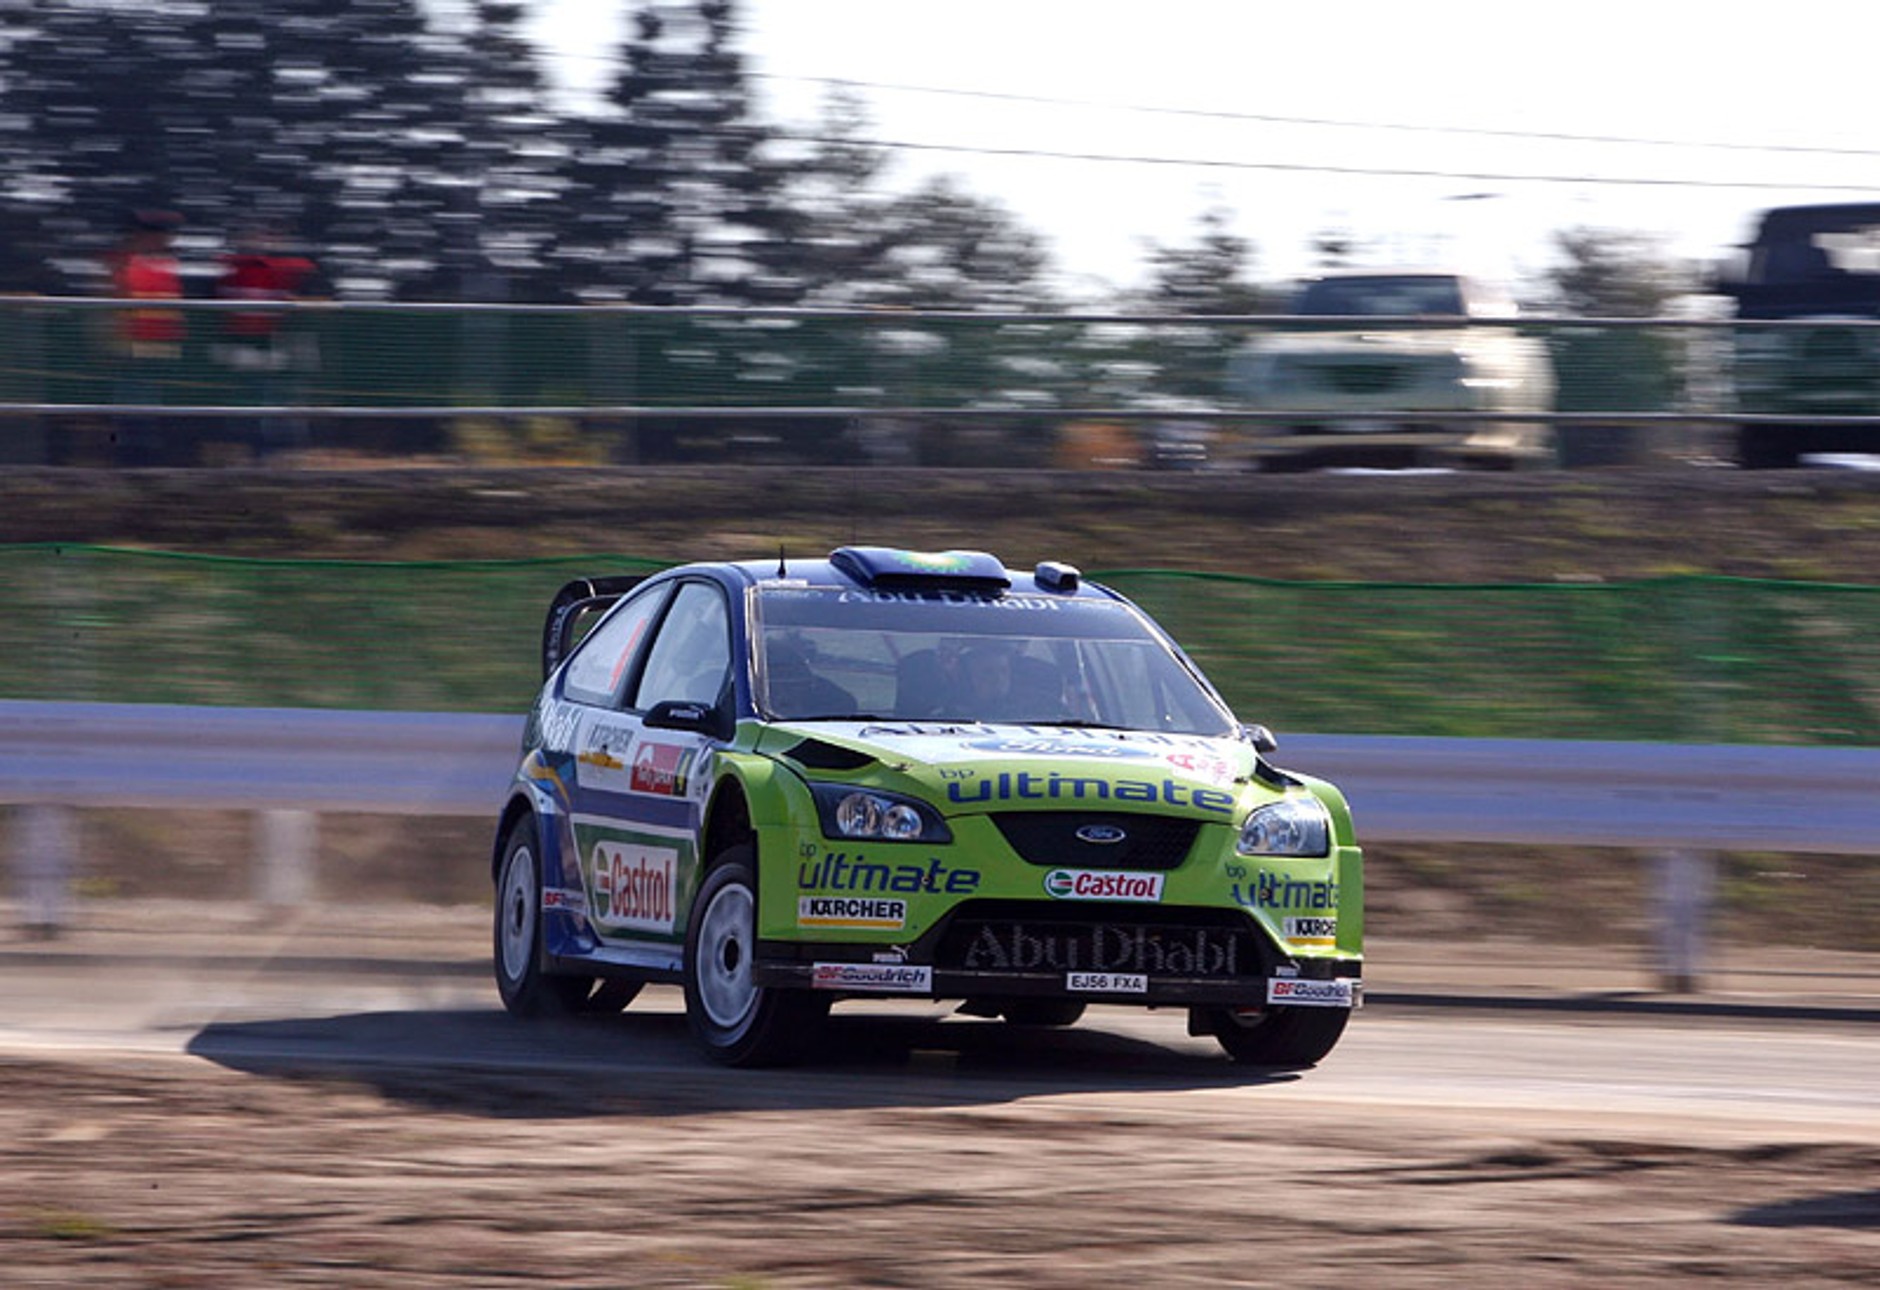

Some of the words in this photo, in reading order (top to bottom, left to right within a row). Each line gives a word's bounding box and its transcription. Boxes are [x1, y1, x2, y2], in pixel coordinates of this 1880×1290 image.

[940, 768, 975, 779] bp
[947, 772, 1233, 813] ultimate
[611, 852, 671, 922] Castrol
[798, 853, 981, 893] ultimate
[1076, 873, 1156, 897] Castrol
[1232, 872, 1339, 908] ultimat
[965, 925, 1078, 968] Abu
[1092, 923, 1237, 974] Dhabi
[817, 965, 926, 984] BFGoodrich
[1072, 975, 1108, 988] EJ56
[1114, 977, 1142, 989] FXA
